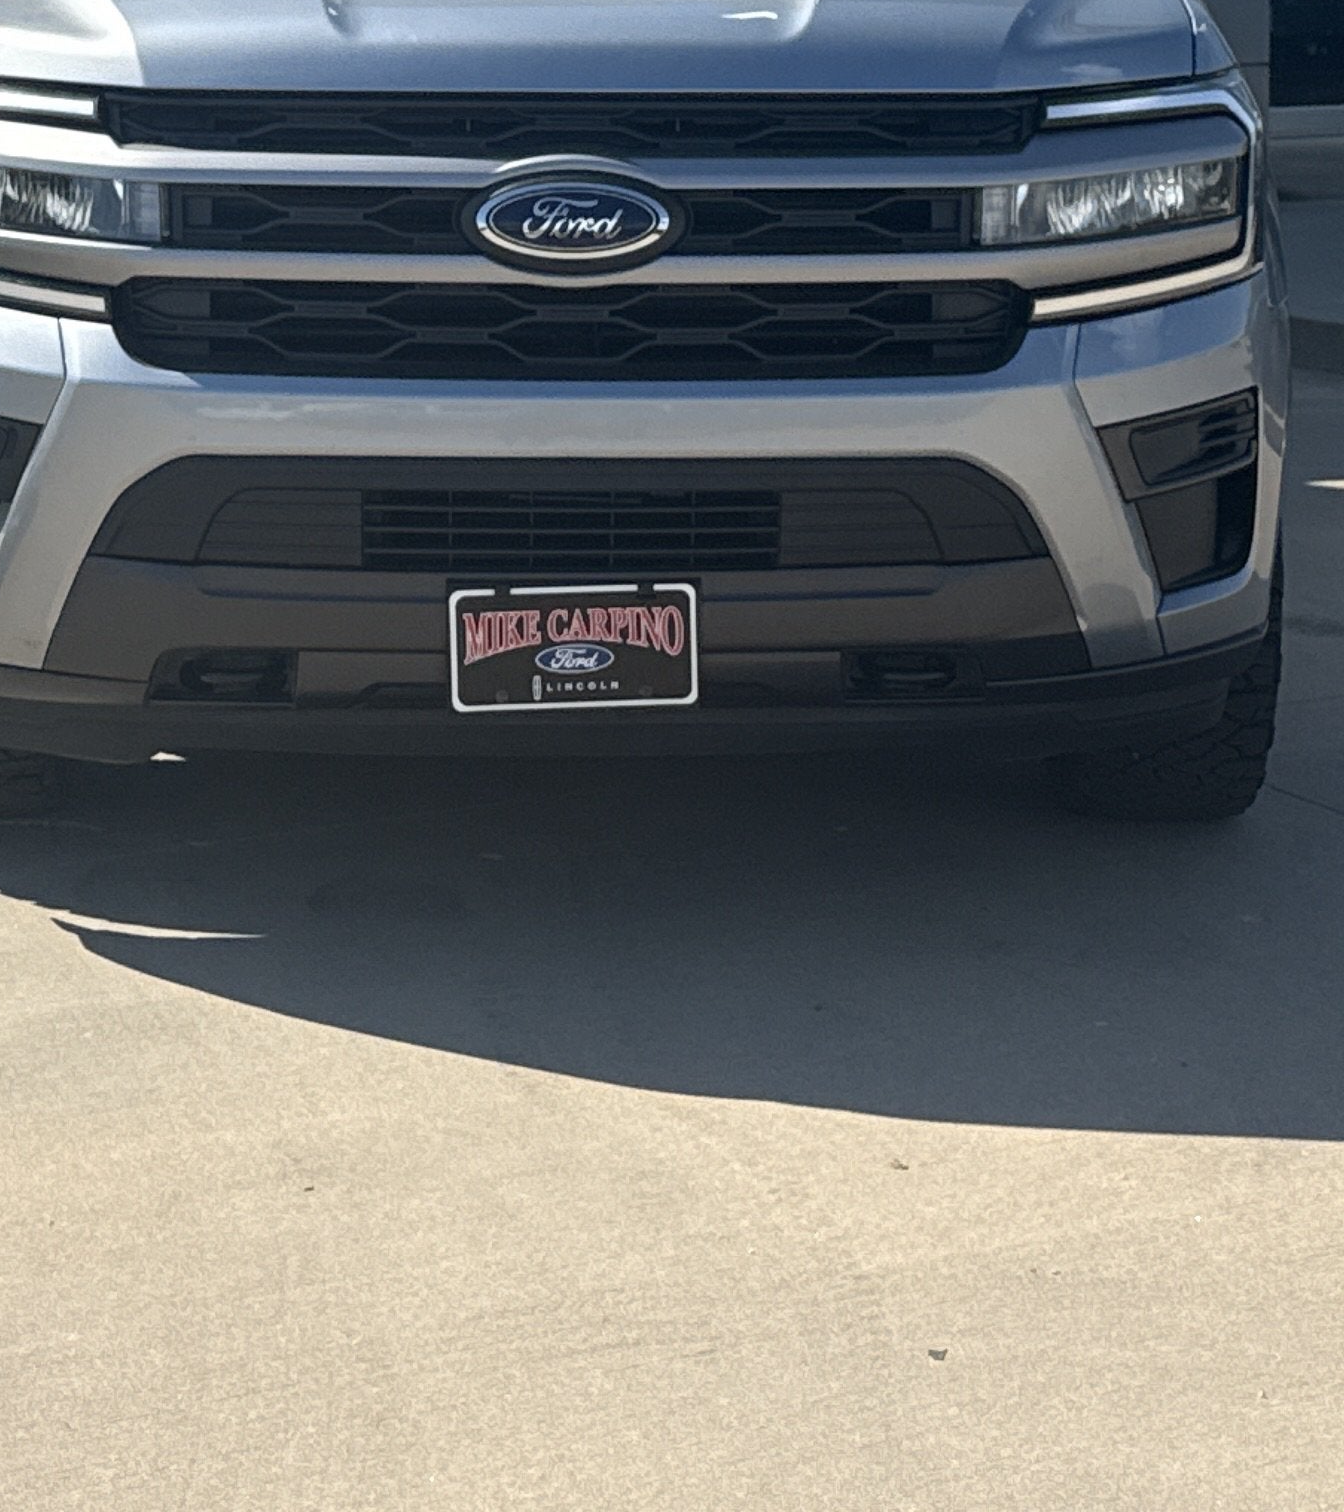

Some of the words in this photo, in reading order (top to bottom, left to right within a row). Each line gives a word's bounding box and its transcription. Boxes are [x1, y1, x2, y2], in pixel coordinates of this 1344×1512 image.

[522, 196, 623, 240] Ford
[462, 609, 542, 666] MIKE
[547, 605, 685, 657] CARPINO
[550, 648, 598, 669] Ford
[546, 681, 620, 693] LINCOLN
